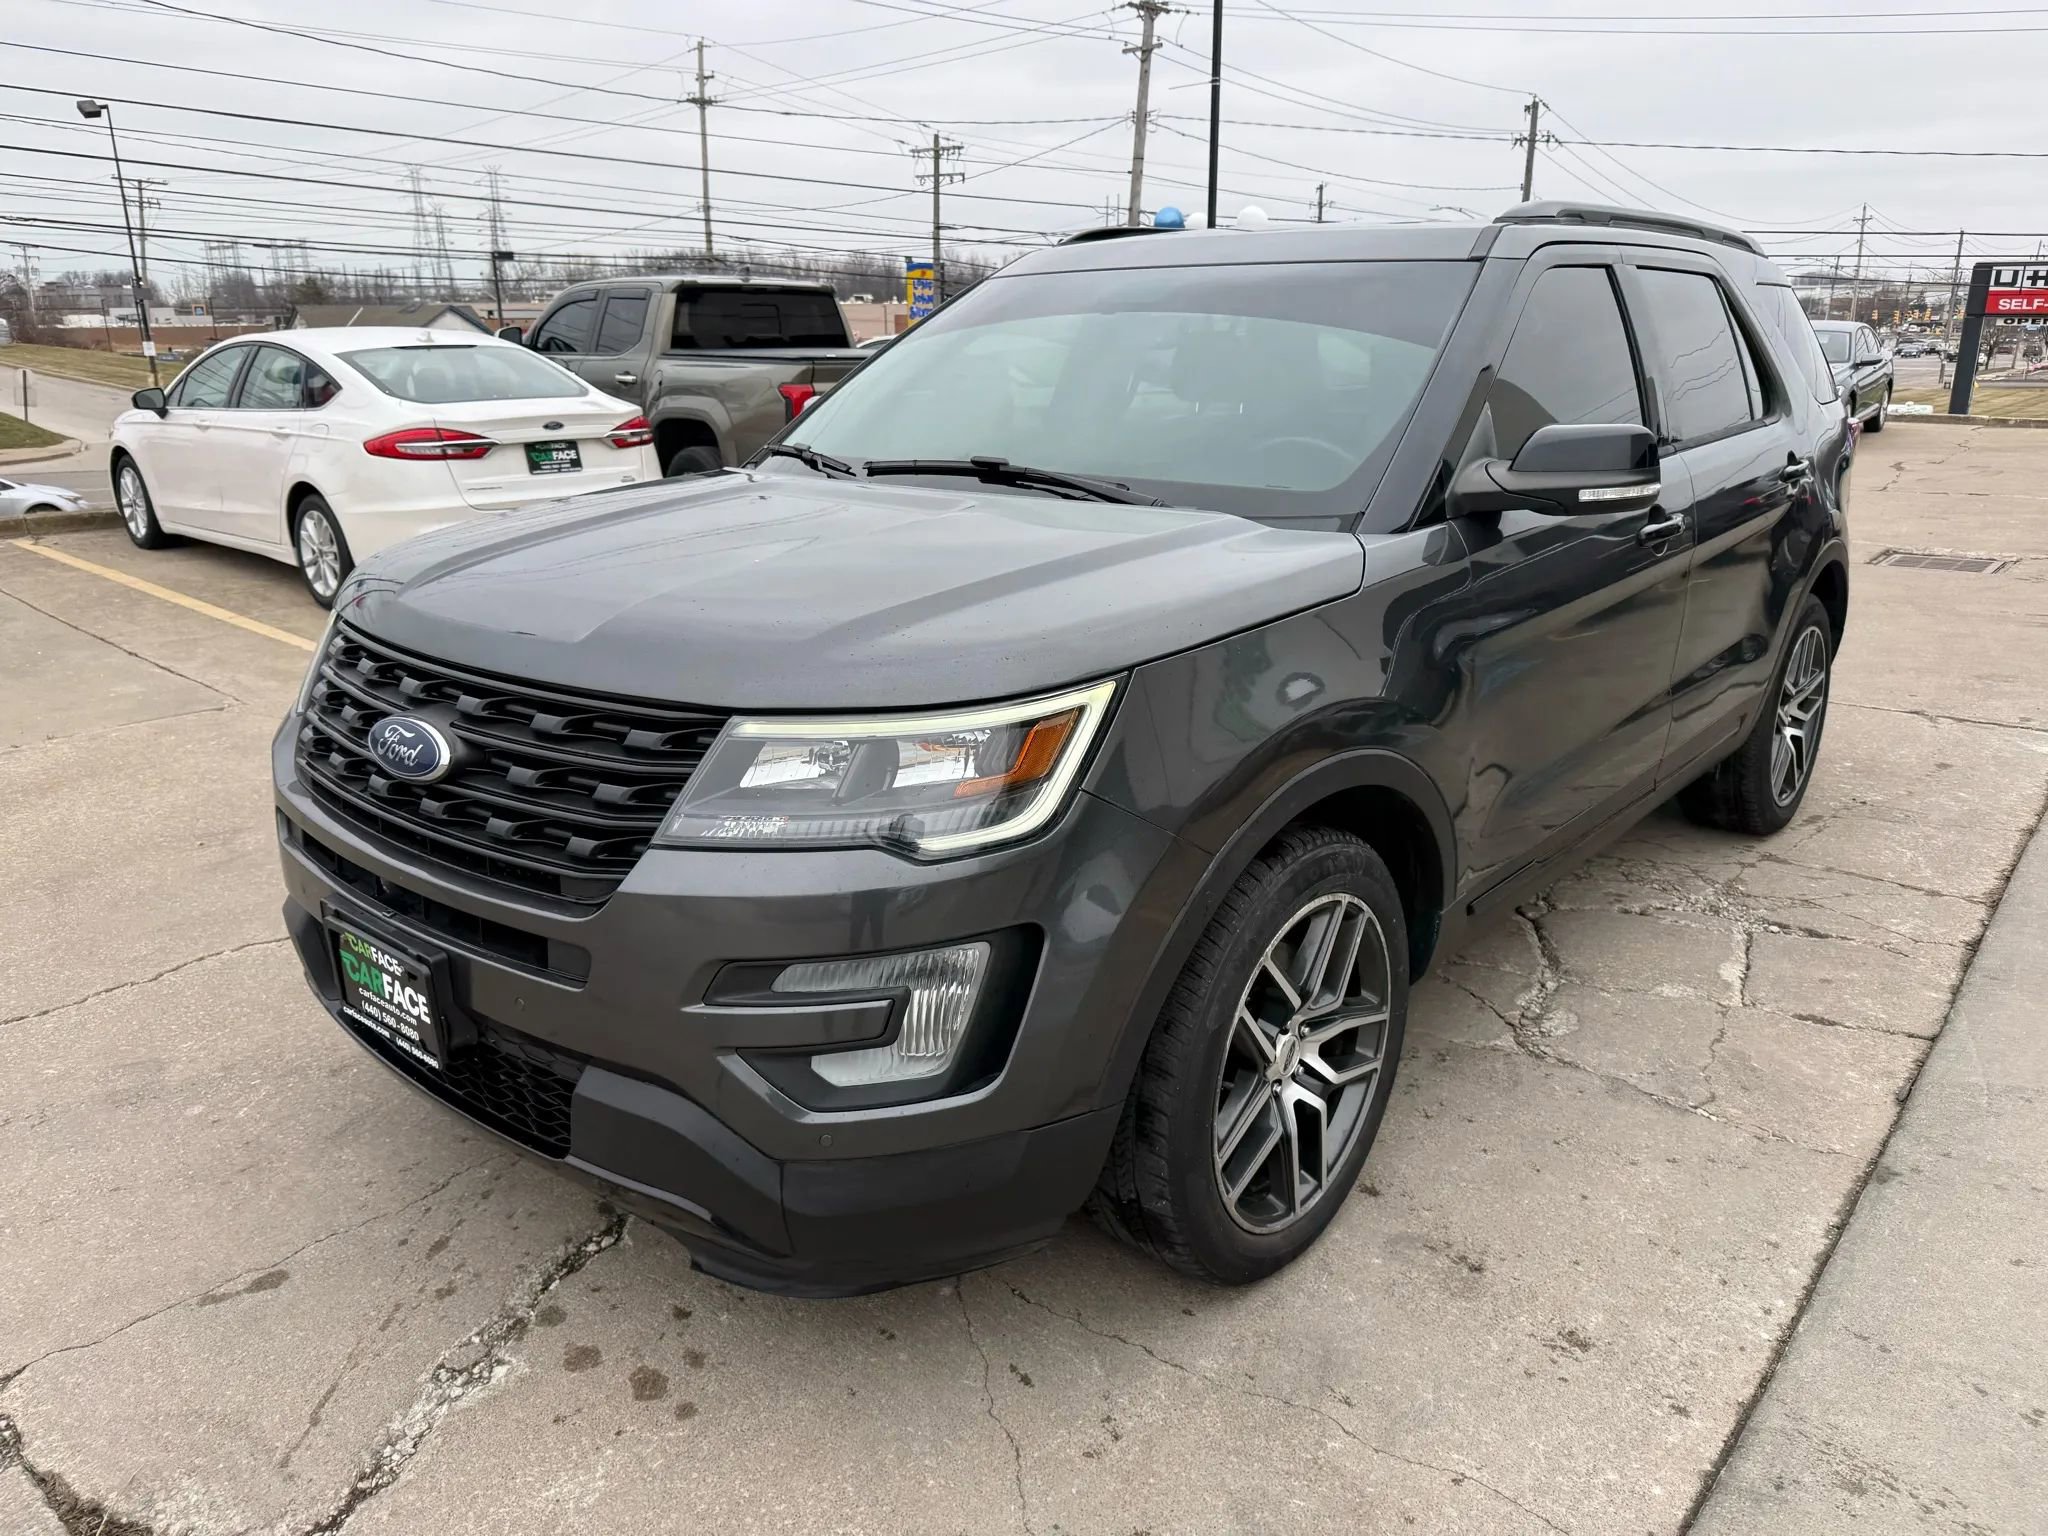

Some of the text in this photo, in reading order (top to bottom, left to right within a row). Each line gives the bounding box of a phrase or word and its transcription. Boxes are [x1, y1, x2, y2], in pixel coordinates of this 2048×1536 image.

[377, 725, 424, 766] Ford
[341, 932, 401, 976] CARFACE
[339, 949, 431, 1025] CARFACE
[358, 987, 418, 1026] carfaceauto.com
[361, 1000, 382, 1021] (440)
